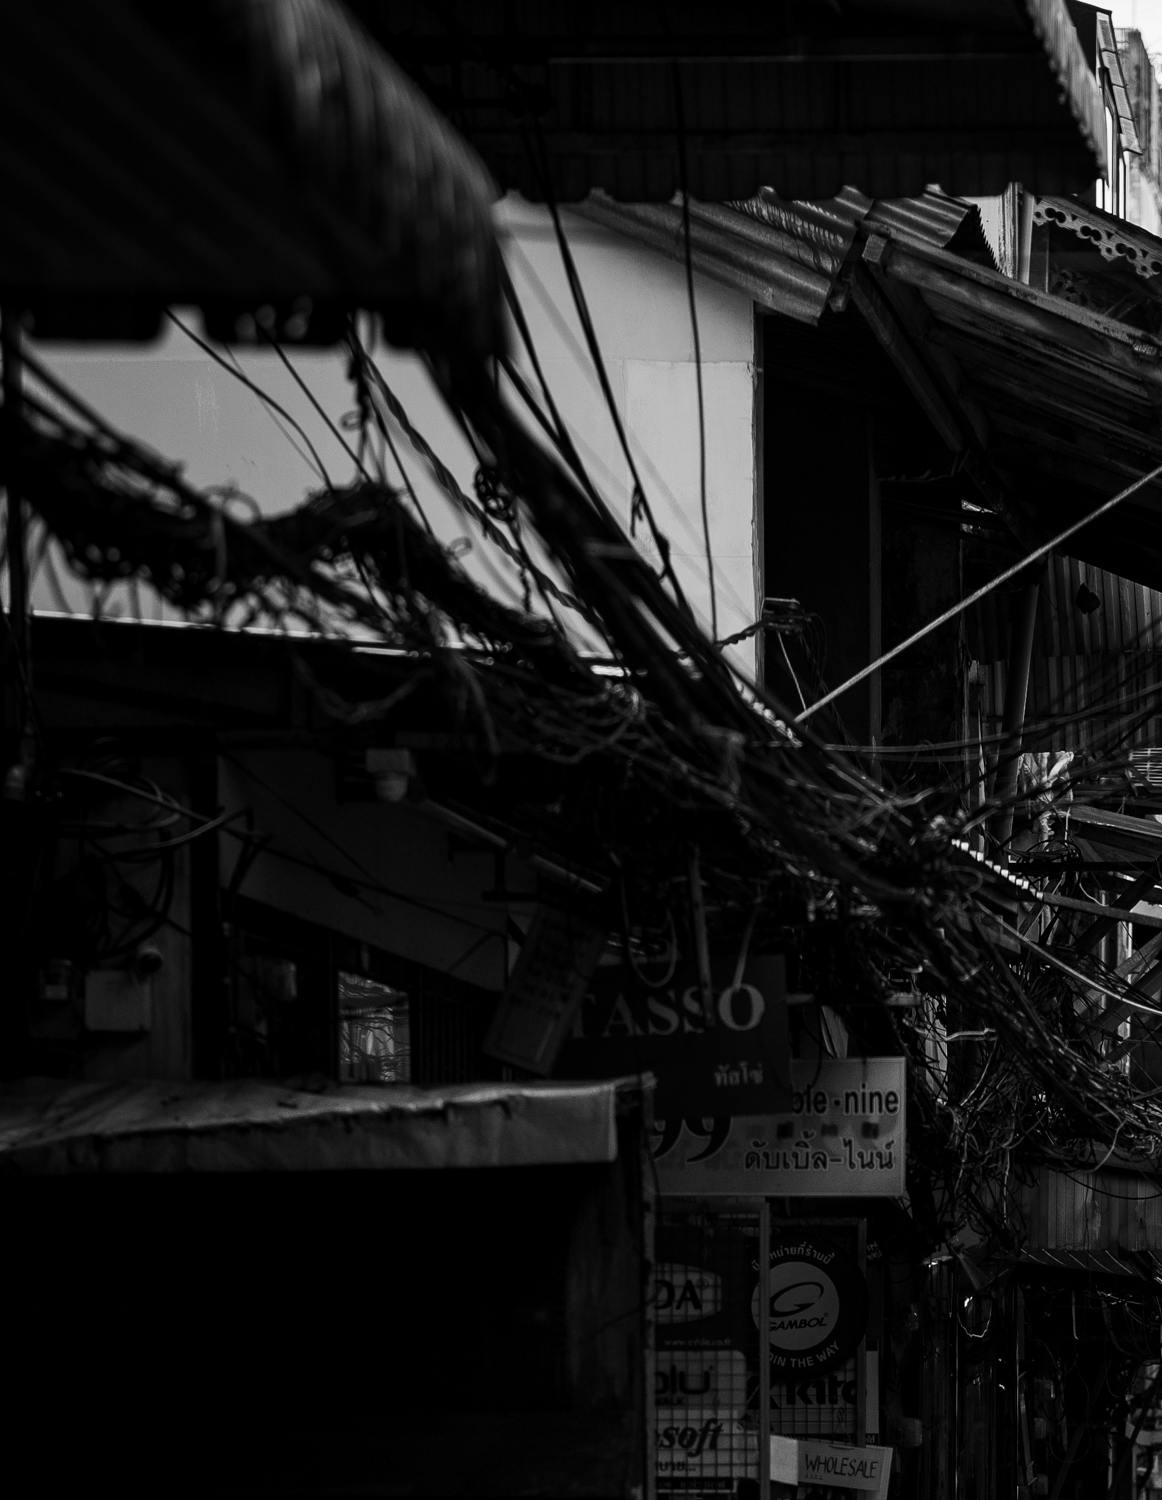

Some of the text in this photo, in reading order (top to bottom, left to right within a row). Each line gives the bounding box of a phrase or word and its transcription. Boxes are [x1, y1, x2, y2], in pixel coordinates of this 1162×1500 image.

[745, 1130, 894, 1169] ดับเบิ้ล-ไนน์
[789, 1356, 815, 1369] THE
[814, 1339, 840, 1363] WAY
[804, 1453, 879, 1480] WHOLESALE
